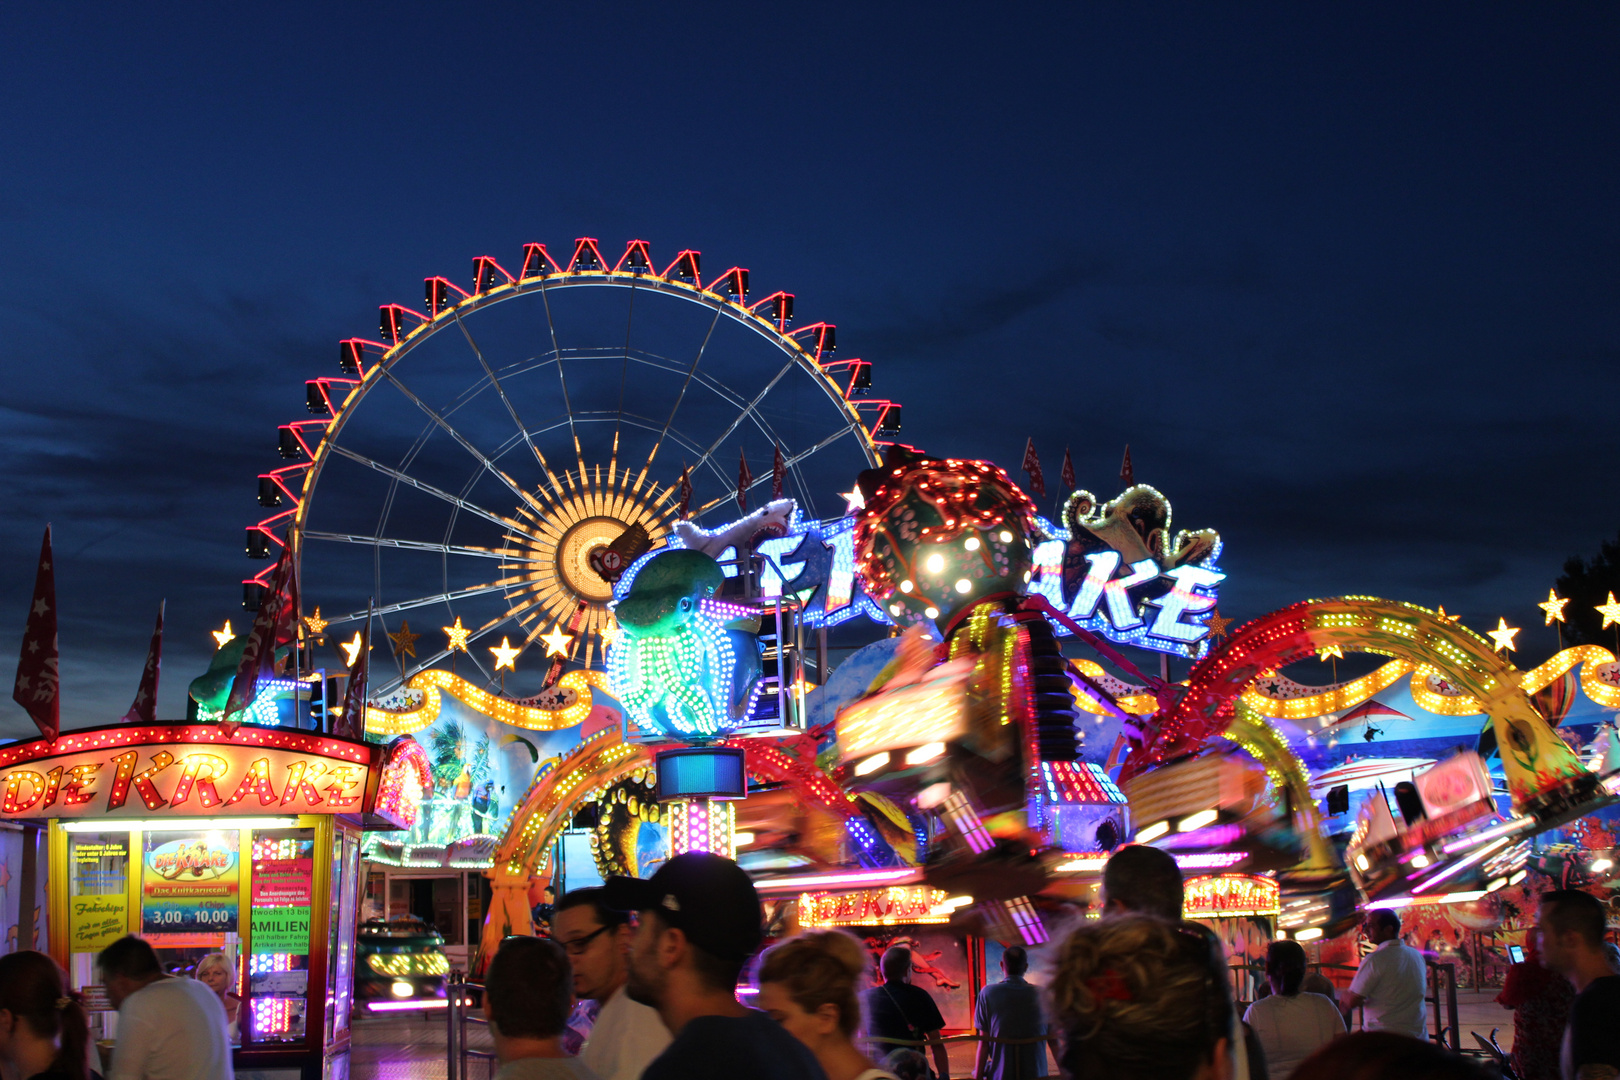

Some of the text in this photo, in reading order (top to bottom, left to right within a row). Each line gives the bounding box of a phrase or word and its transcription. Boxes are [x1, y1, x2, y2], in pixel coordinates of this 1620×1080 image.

[1, 763, 104, 813] DIE
[106, 750, 362, 812] KRAKE
[154, 848, 228, 869] DIE KRAKE
[163, 901, 179, 910] Chip
[205, 901, 225, 909] Chips
[821, 893, 857, 920] DIE
[860, 886, 949, 918] KRAK
[153, 910, 229, 925] 3,00 10,00
[251, 921, 308, 932] AMILIEN
